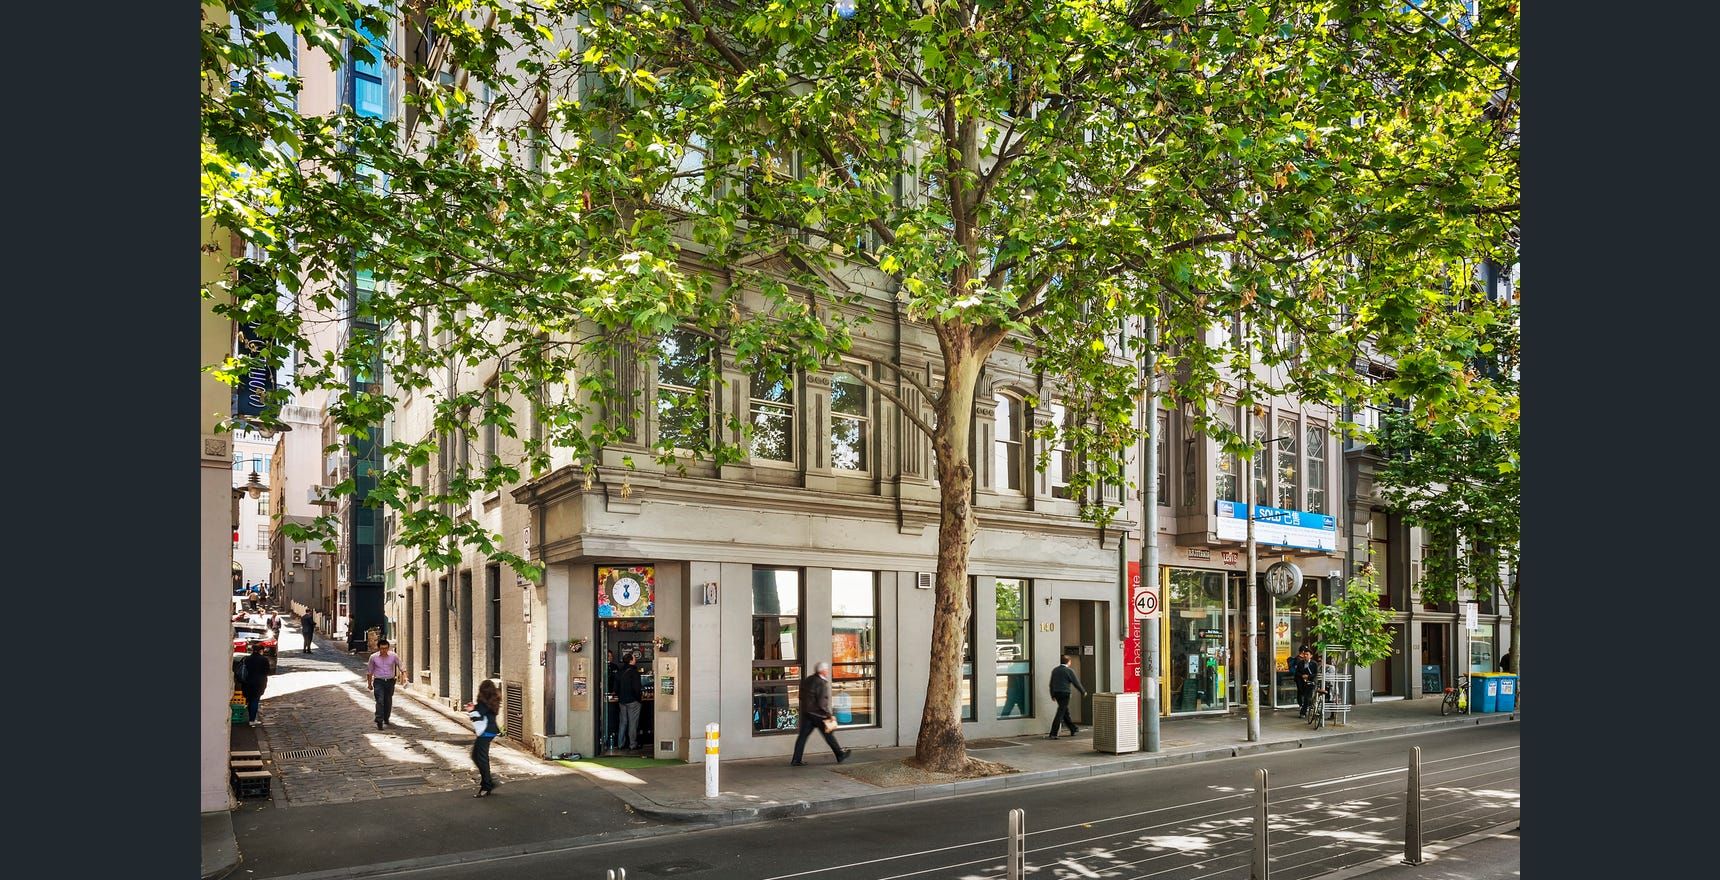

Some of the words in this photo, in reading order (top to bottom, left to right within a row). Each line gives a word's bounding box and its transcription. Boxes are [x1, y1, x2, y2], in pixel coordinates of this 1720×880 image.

[1259, 508, 1281, 522] SOLD
[1137, 597, 1155, 609] 40
[1039, 622, 1055, 632] 140
